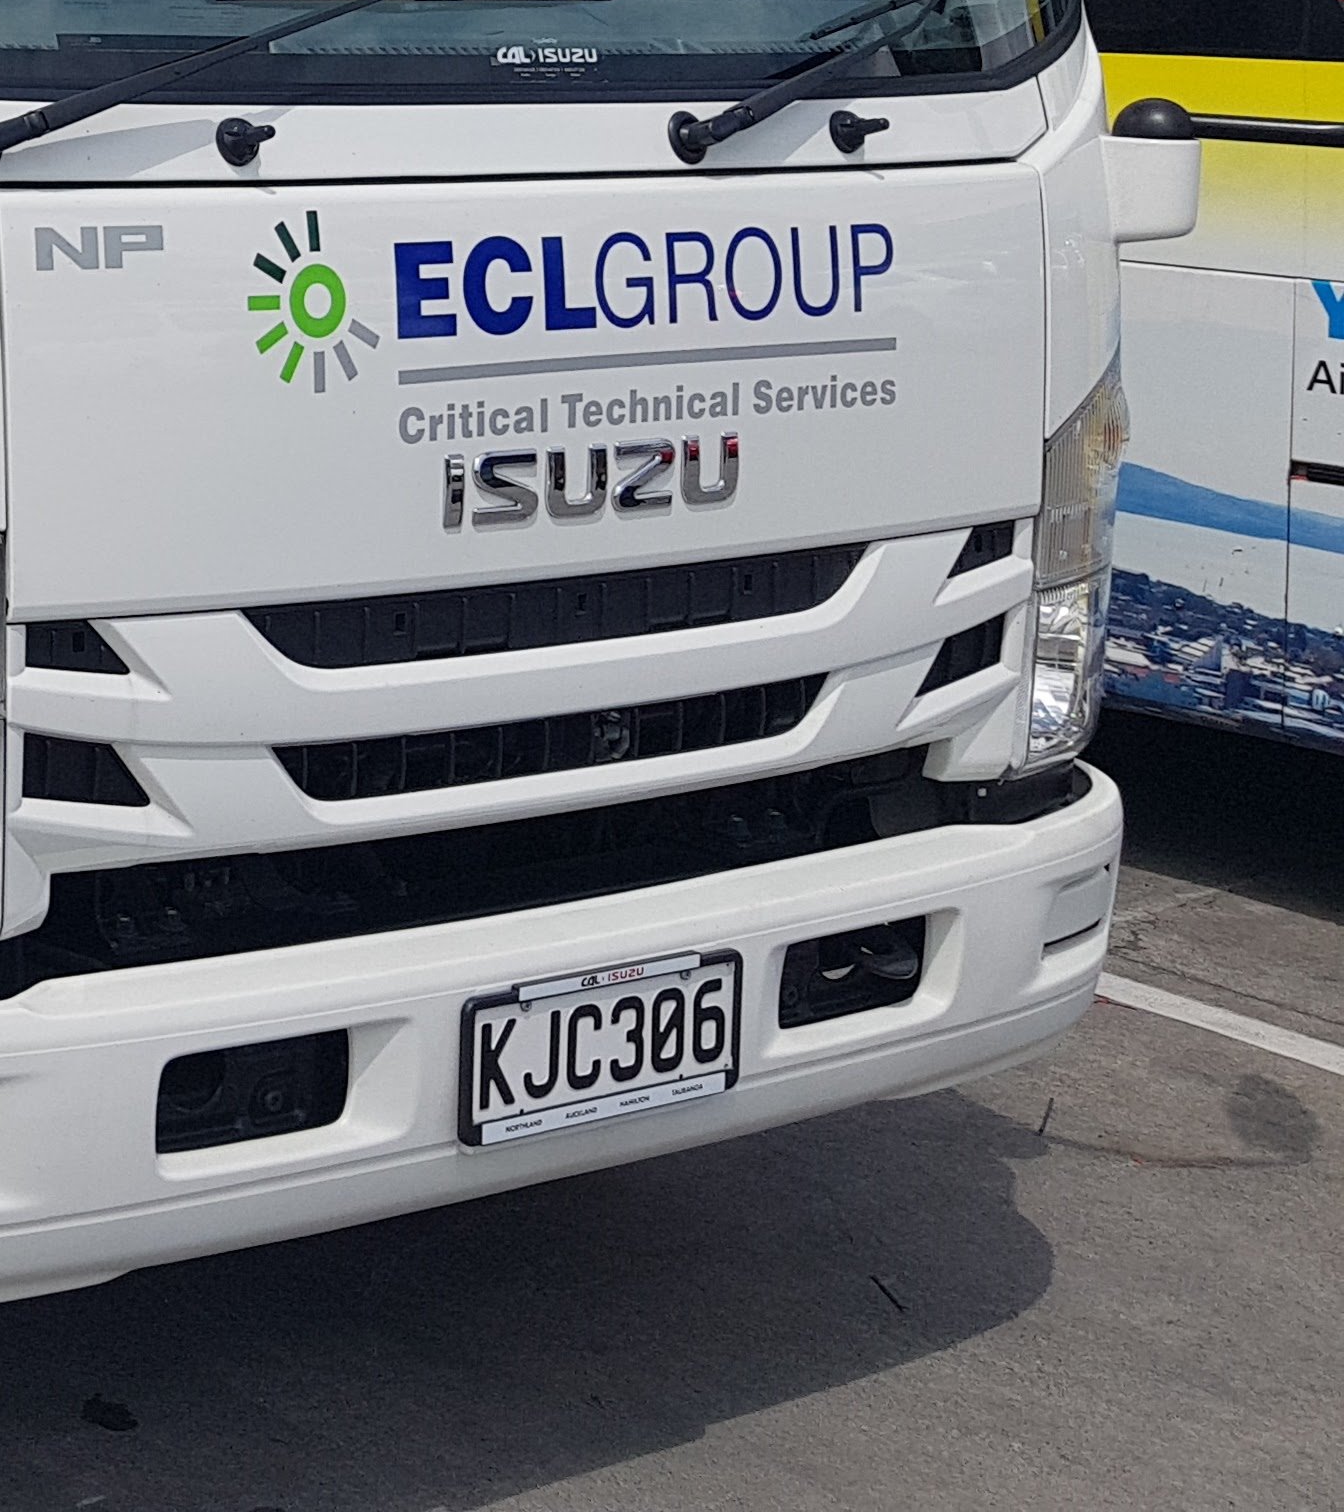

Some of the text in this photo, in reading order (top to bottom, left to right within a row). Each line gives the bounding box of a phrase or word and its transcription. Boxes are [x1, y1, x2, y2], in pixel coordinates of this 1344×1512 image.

[537, 47, 598, 63] ISUZU
[35, 225, 164, 271] NP
[394, 223, 895, 340] ECLGROUP
[398, 375, 897, 444] Critical Technical Services
[442, 431, 740, 534] ISUZU
[608, 966, 645, 982] ISUZU
[478, 977, 726, 1111] KJC306
[505, 1119, 543, 1133] NORTHLAND
[565, 1106, 598, 1120] AUCKLAND
[619, 1095, 651, 1107] HAMILTON
